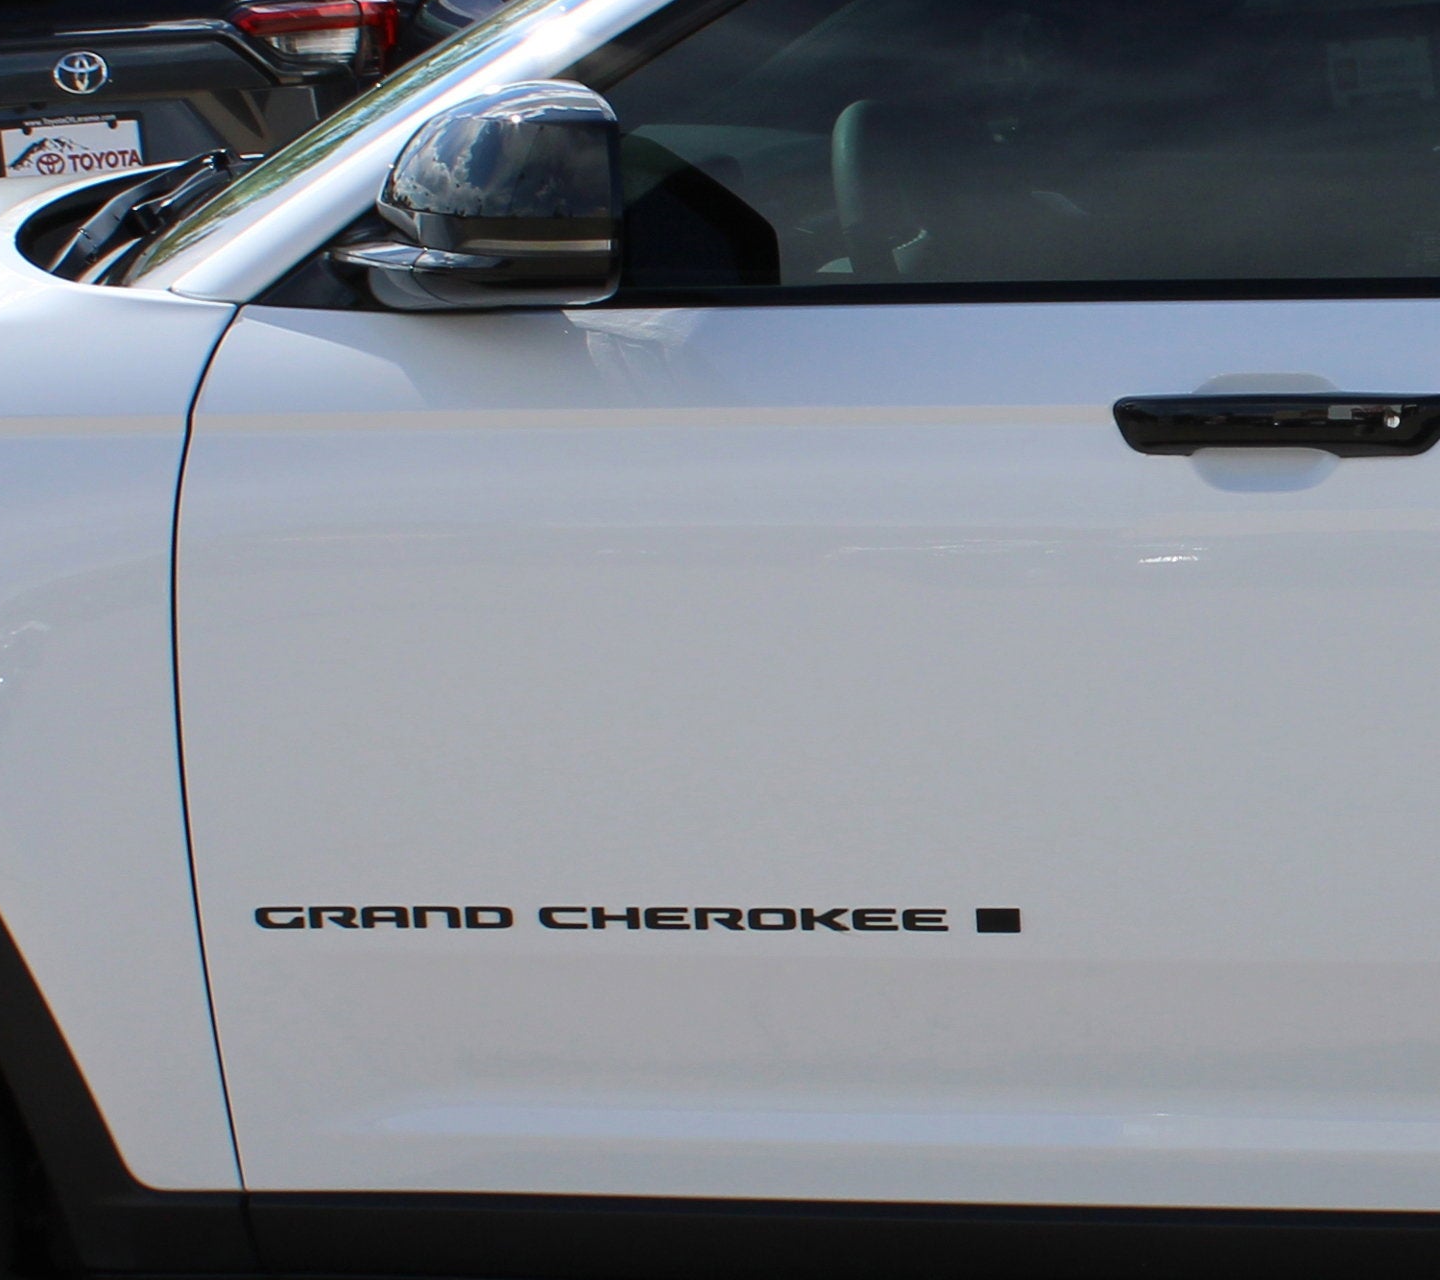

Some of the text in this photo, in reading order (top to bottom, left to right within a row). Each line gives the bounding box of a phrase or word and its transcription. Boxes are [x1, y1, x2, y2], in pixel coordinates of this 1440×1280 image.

[67, 149, 144, 172] TOYOTA
[253, 906, 950, 933] GRAND CHEROKEE
